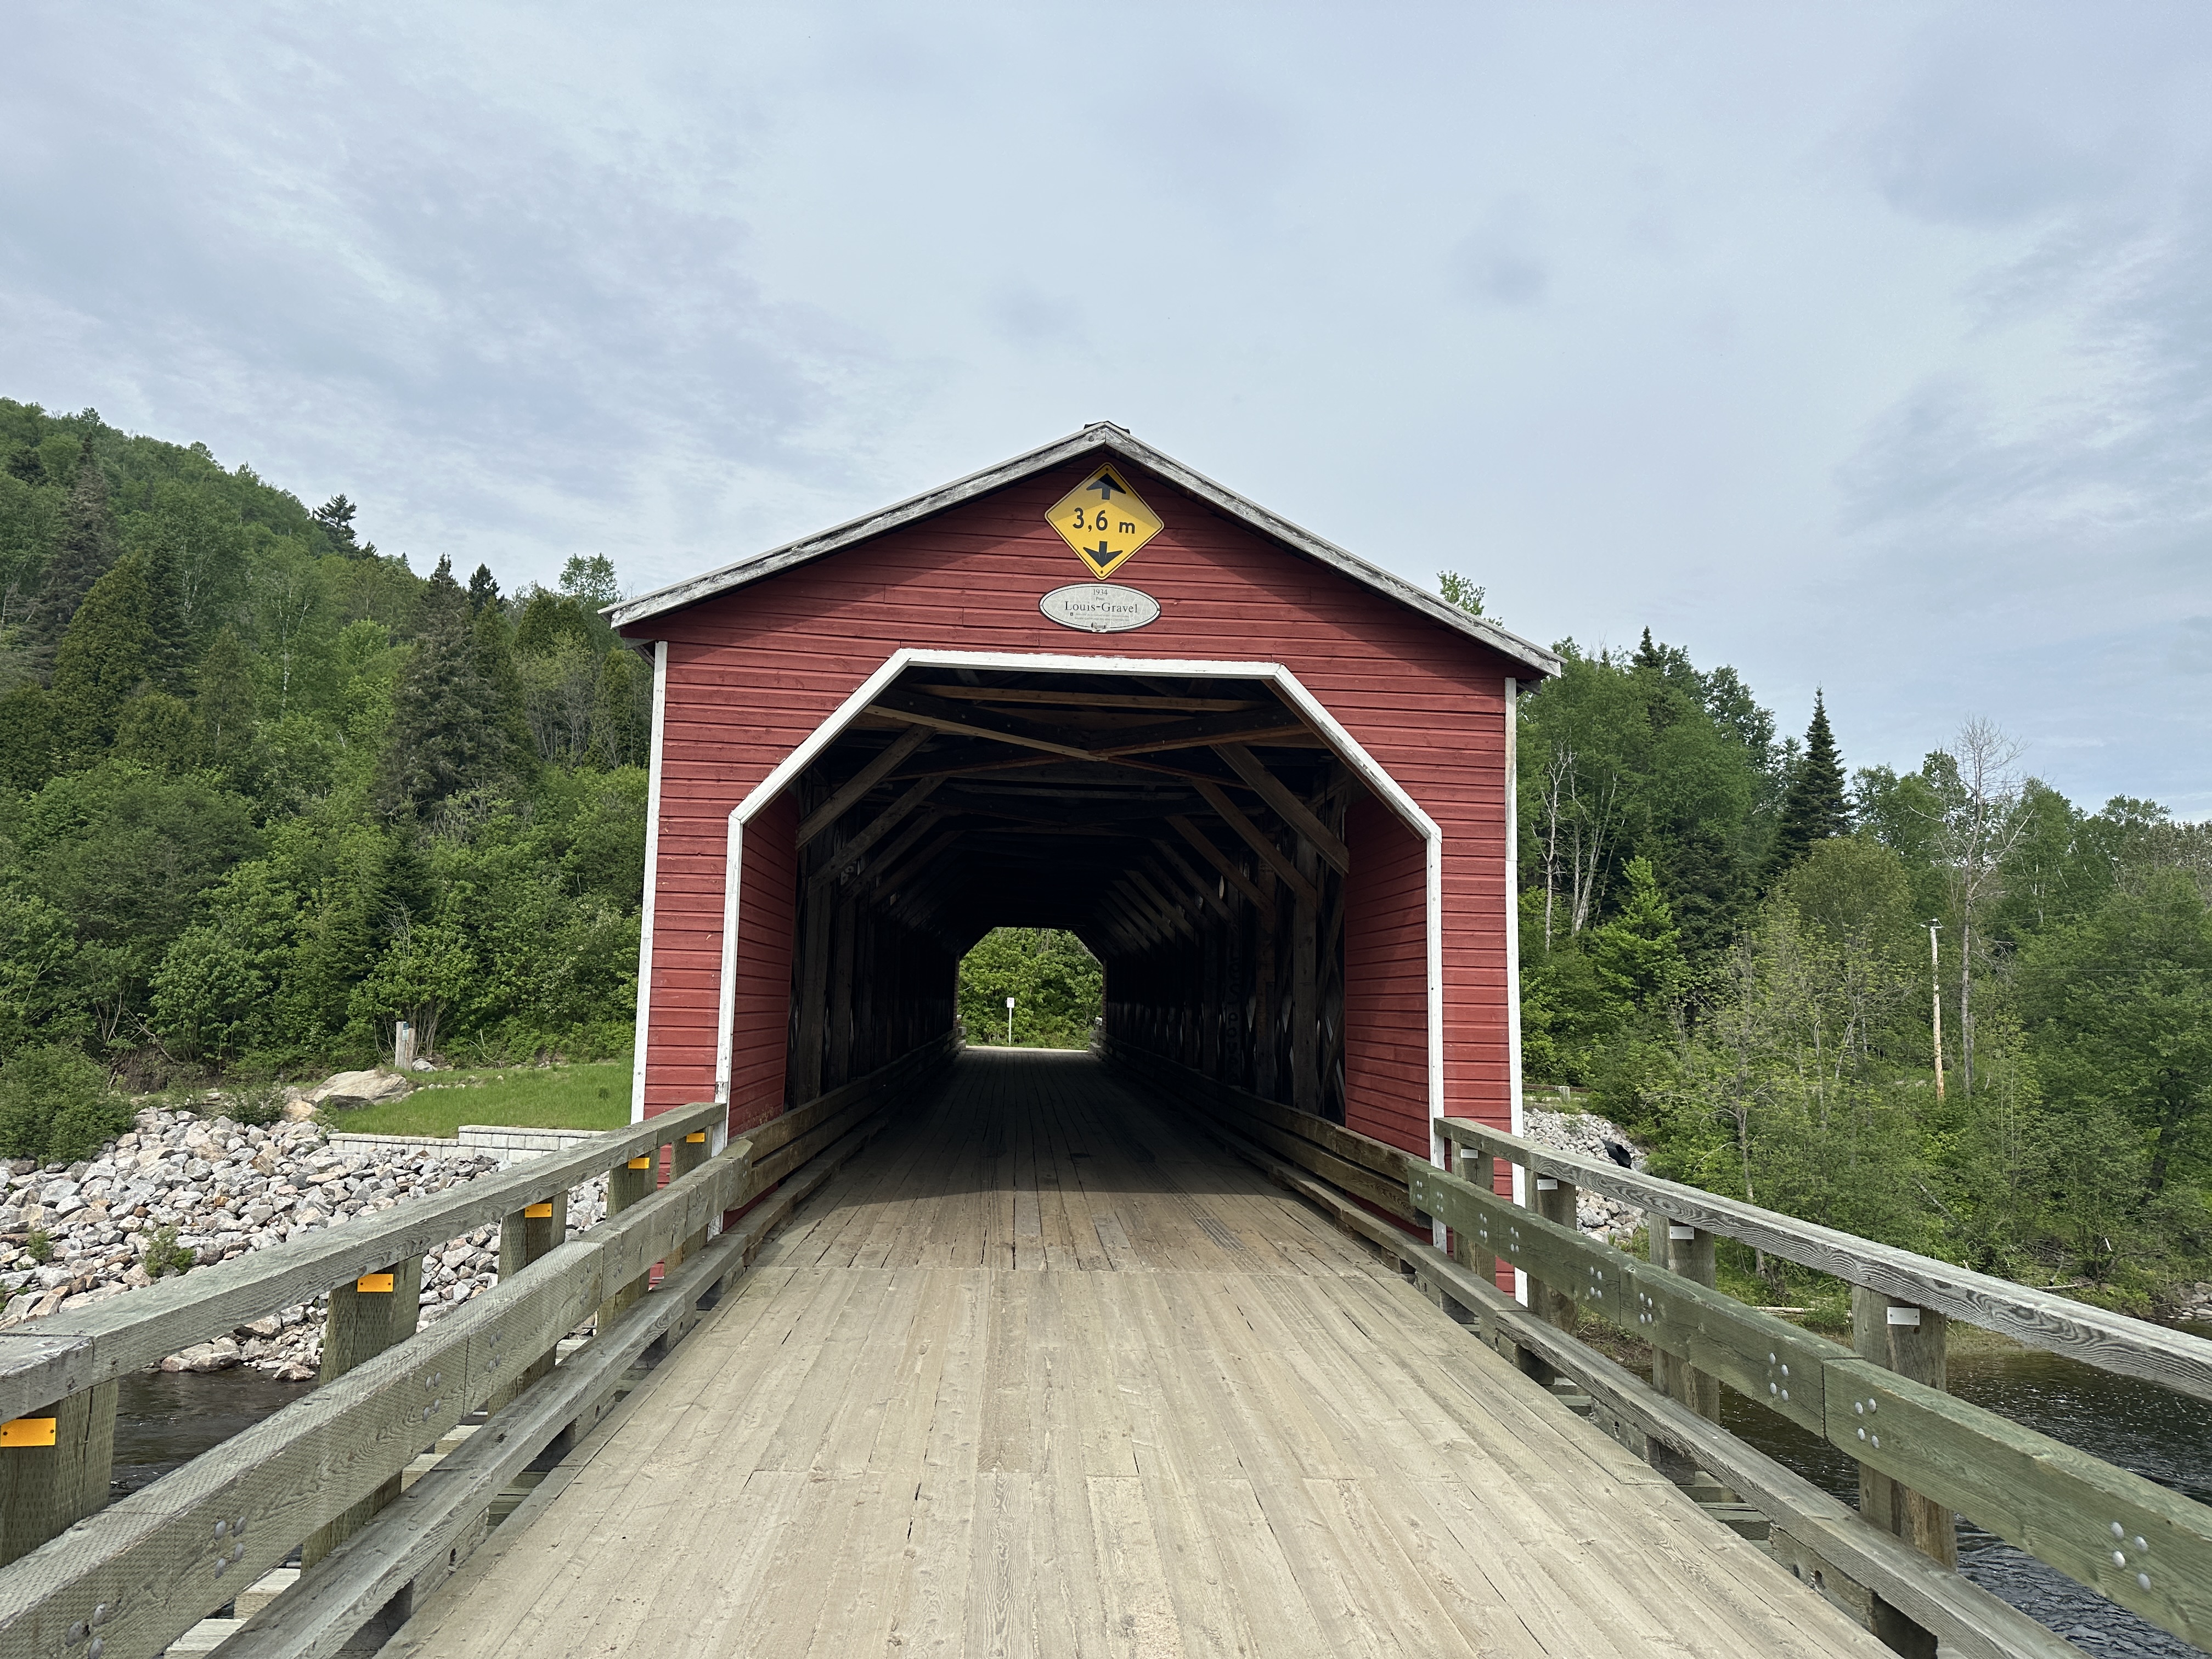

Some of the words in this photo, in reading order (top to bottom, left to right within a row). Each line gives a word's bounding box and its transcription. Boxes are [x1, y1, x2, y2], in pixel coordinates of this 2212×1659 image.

[1073, 507, 1108, 532] 3,6
[1119, 521, 1135, 534] m
[1064, 601, 1138, 613] Louis-Gravel
